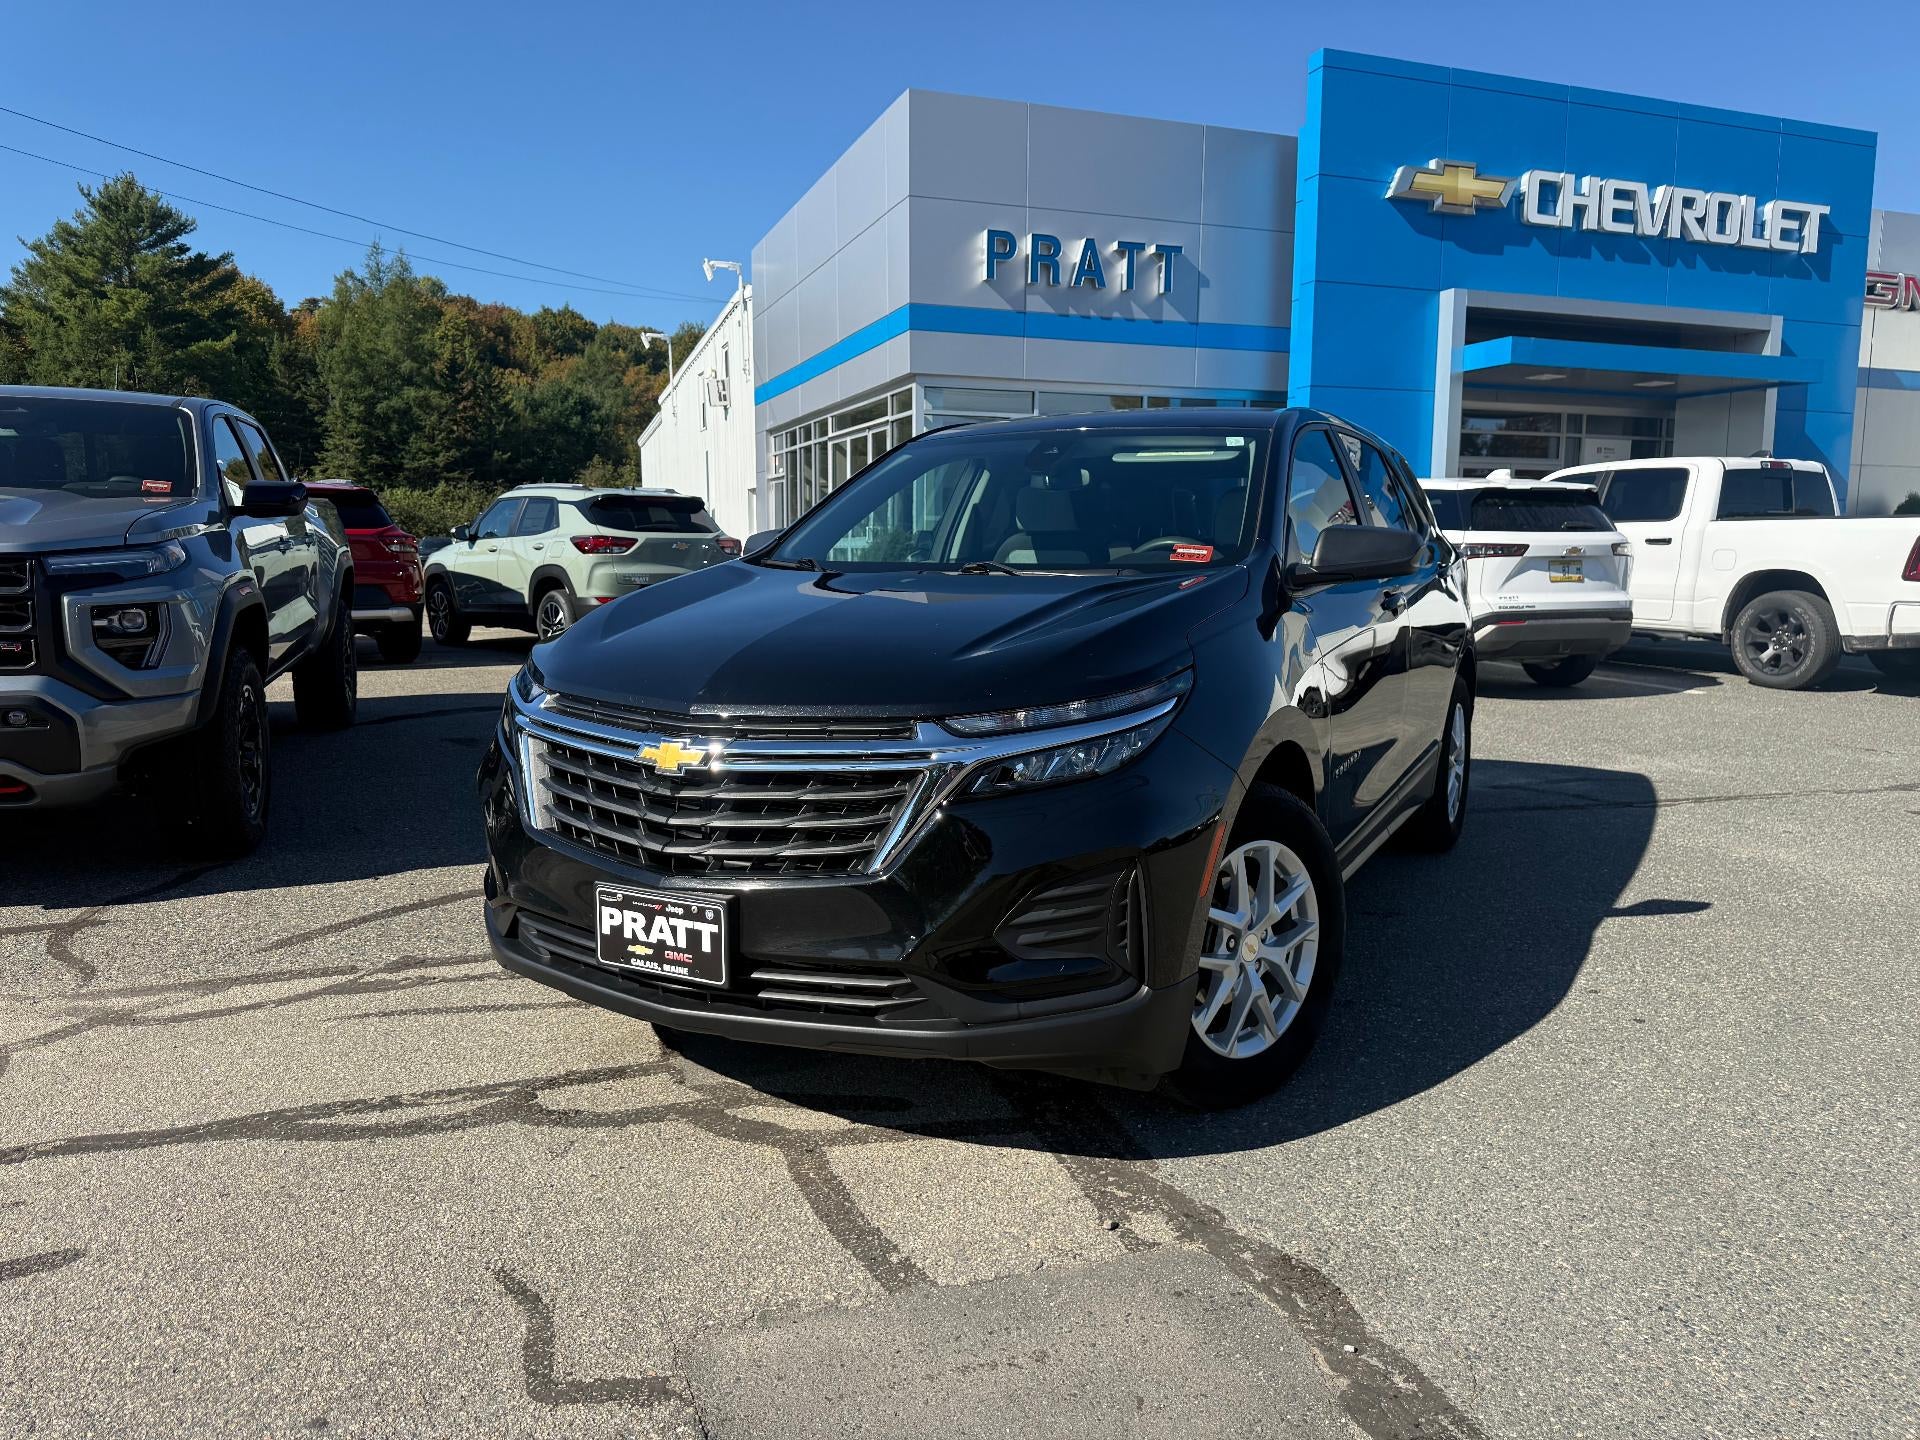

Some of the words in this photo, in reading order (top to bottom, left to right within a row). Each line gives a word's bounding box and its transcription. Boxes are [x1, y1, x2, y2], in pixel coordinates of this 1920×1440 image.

[1520, 169, 1830, 254] CHEVROLET
[982, 229, 1184, 294] PRATT
[665, 904, 684, 915] Jeep
[601, 905, 719, 953] PRATT
[662, 963, 689, 975] MAINE
[664, 950, 693, 963] GMC
